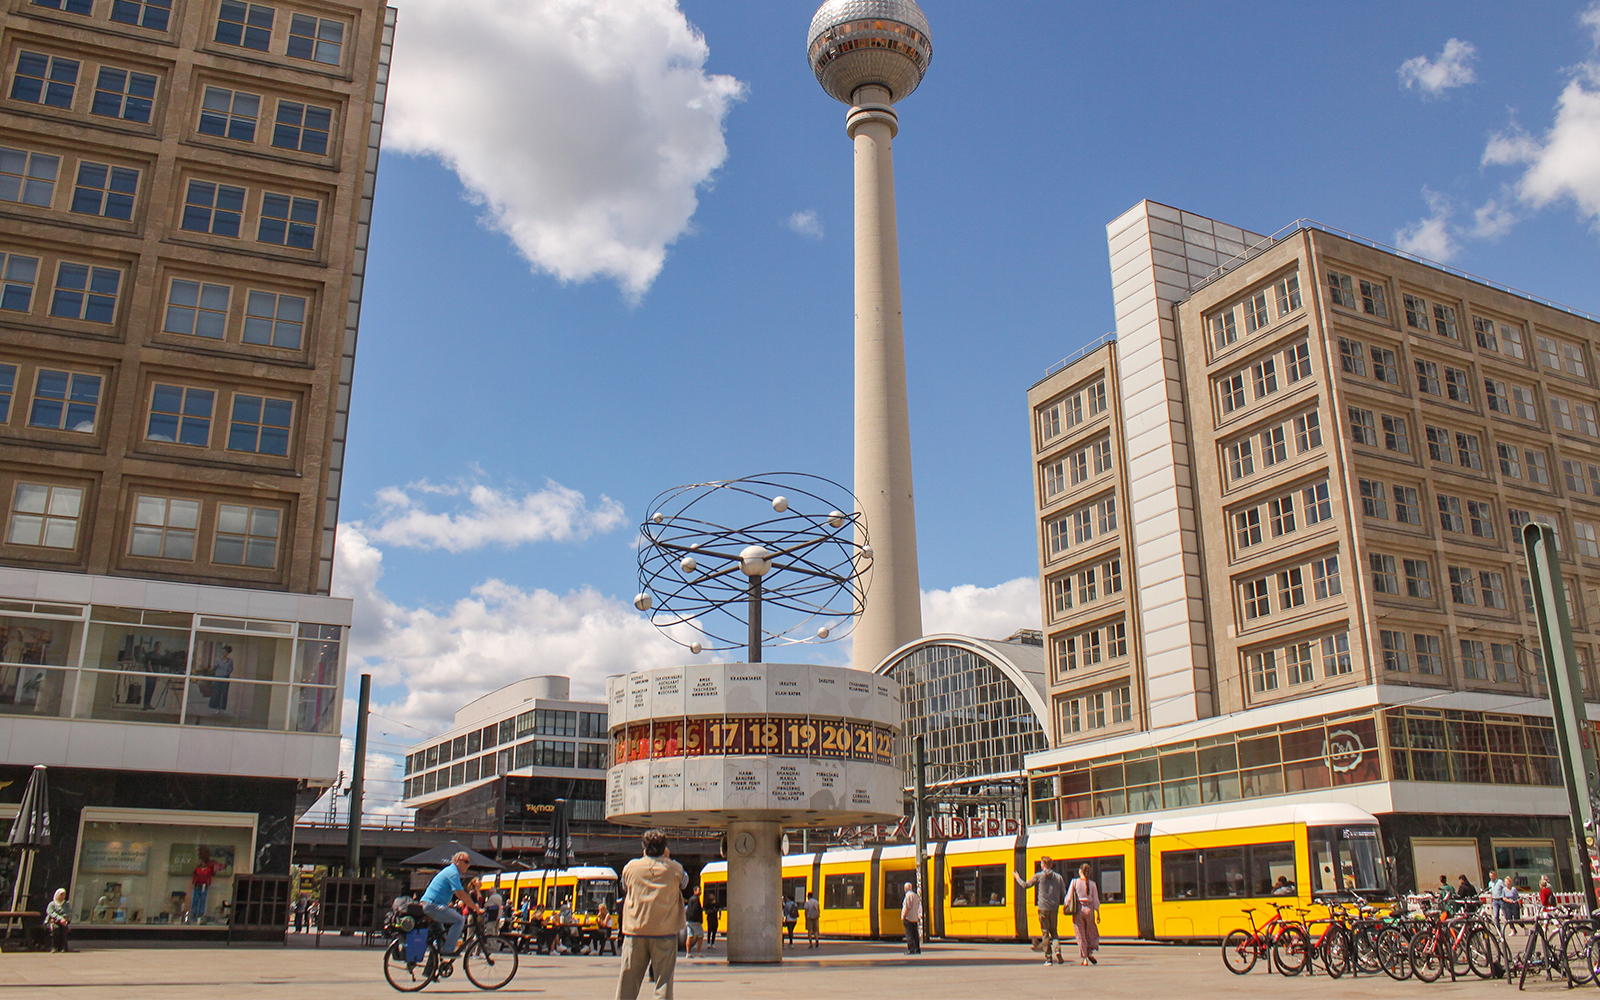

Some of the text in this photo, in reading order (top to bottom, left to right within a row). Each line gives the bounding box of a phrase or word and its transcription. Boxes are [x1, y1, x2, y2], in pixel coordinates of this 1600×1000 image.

[674, 725, 701, 749] 16
[710, 724, 739, 747] 17
[749, 724, 779, 747] 18
[788, 724, 817, 748] 19
[823, 726, 851, 751] 20
[855, 729, 874, 753] 21
[877, 733, 891, 757] 22
[1331, 740, 1357, 760] C&A
[174, 857, 192, 865] DAY
